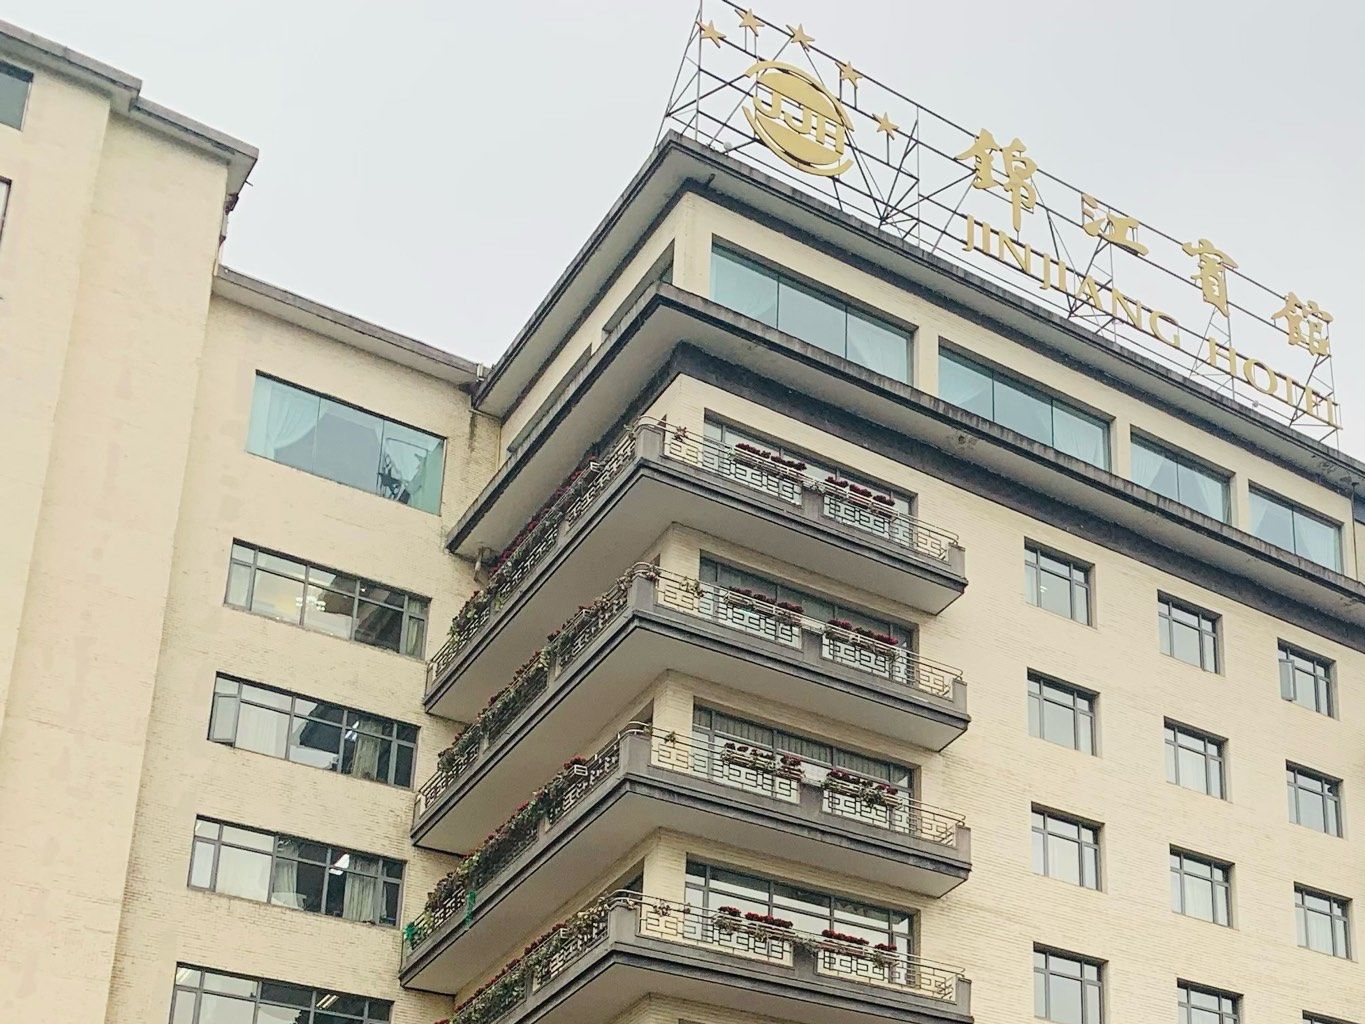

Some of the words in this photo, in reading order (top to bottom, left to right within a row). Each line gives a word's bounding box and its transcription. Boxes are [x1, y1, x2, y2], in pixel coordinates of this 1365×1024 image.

[753, 90, 845, 156] JJH
[962, 213, 1181, 348] JINJIANG
[1208, 336, 1339, 428] HOTEL
